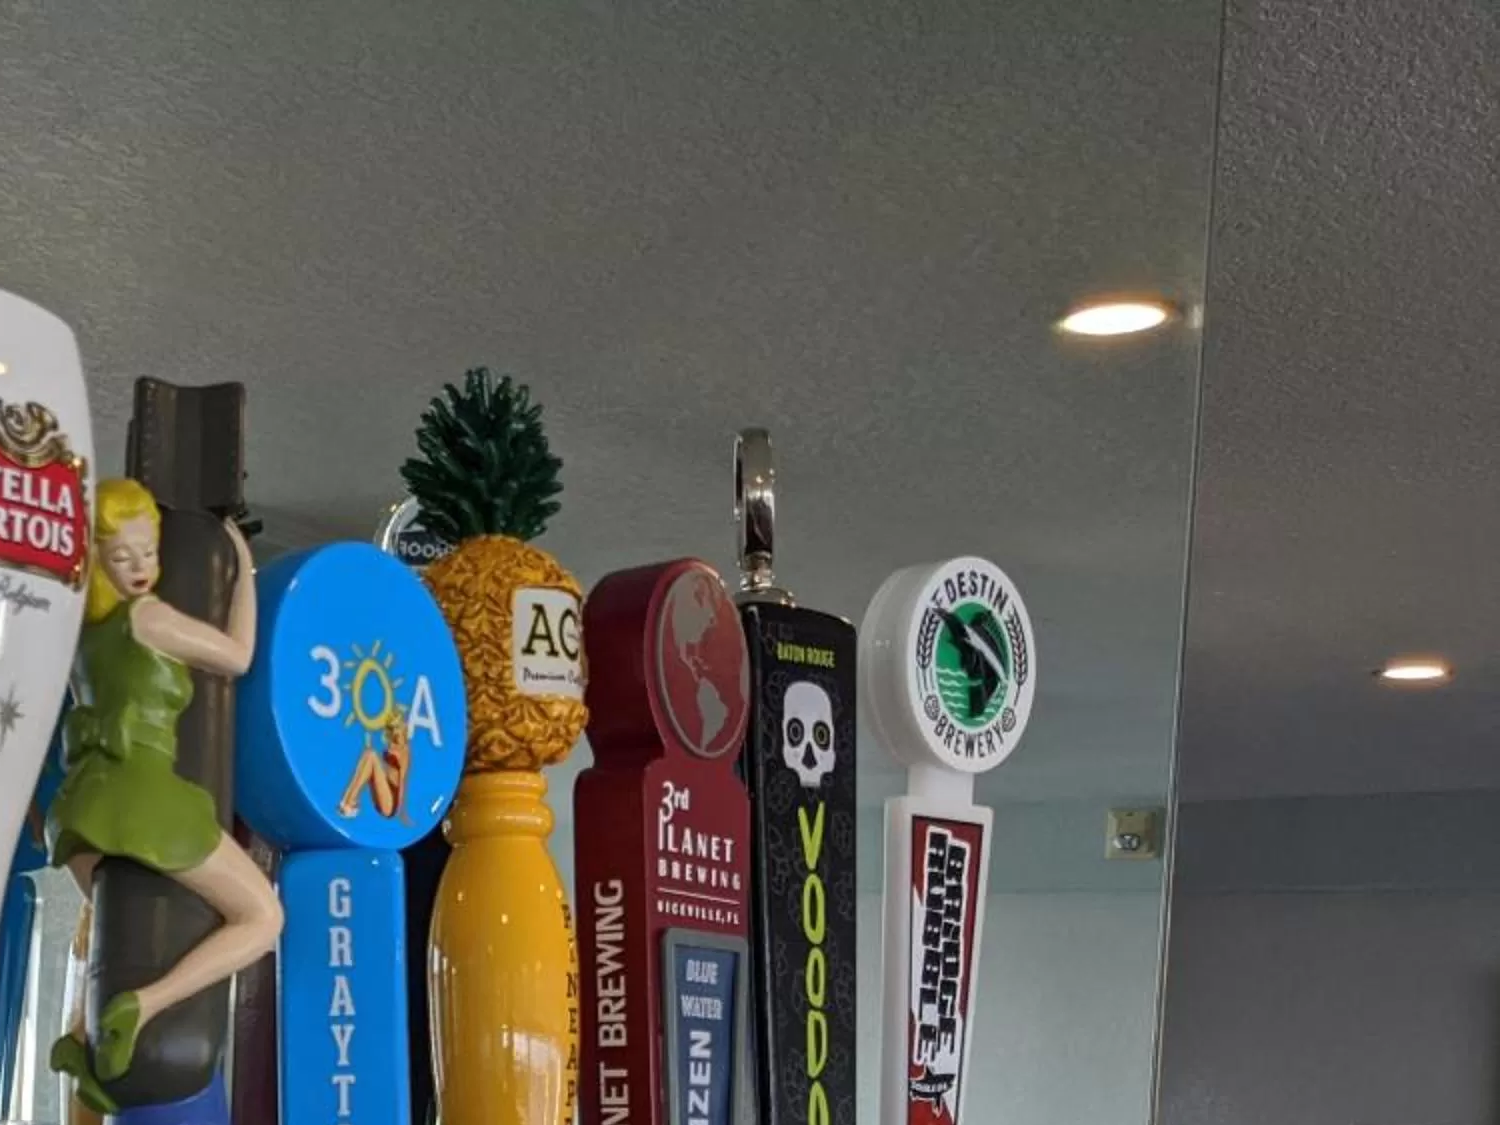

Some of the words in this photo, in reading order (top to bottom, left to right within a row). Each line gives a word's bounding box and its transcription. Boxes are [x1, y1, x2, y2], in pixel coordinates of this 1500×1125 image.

[943, 569, 1010, 616] DESTIN
[520, 602, 579, 661] AC
[933, 711, 1006, 760] BREWERY
[661, 780, 690, 823] 3rd
[657, 806, 734, 863] PLANET
[657, 858, 741, 891] BREWING
[594, 878, 628, 1049] BREWING
[684, 958, 720, 986] BLUE
[679, 993, 724, 1021] WATER
